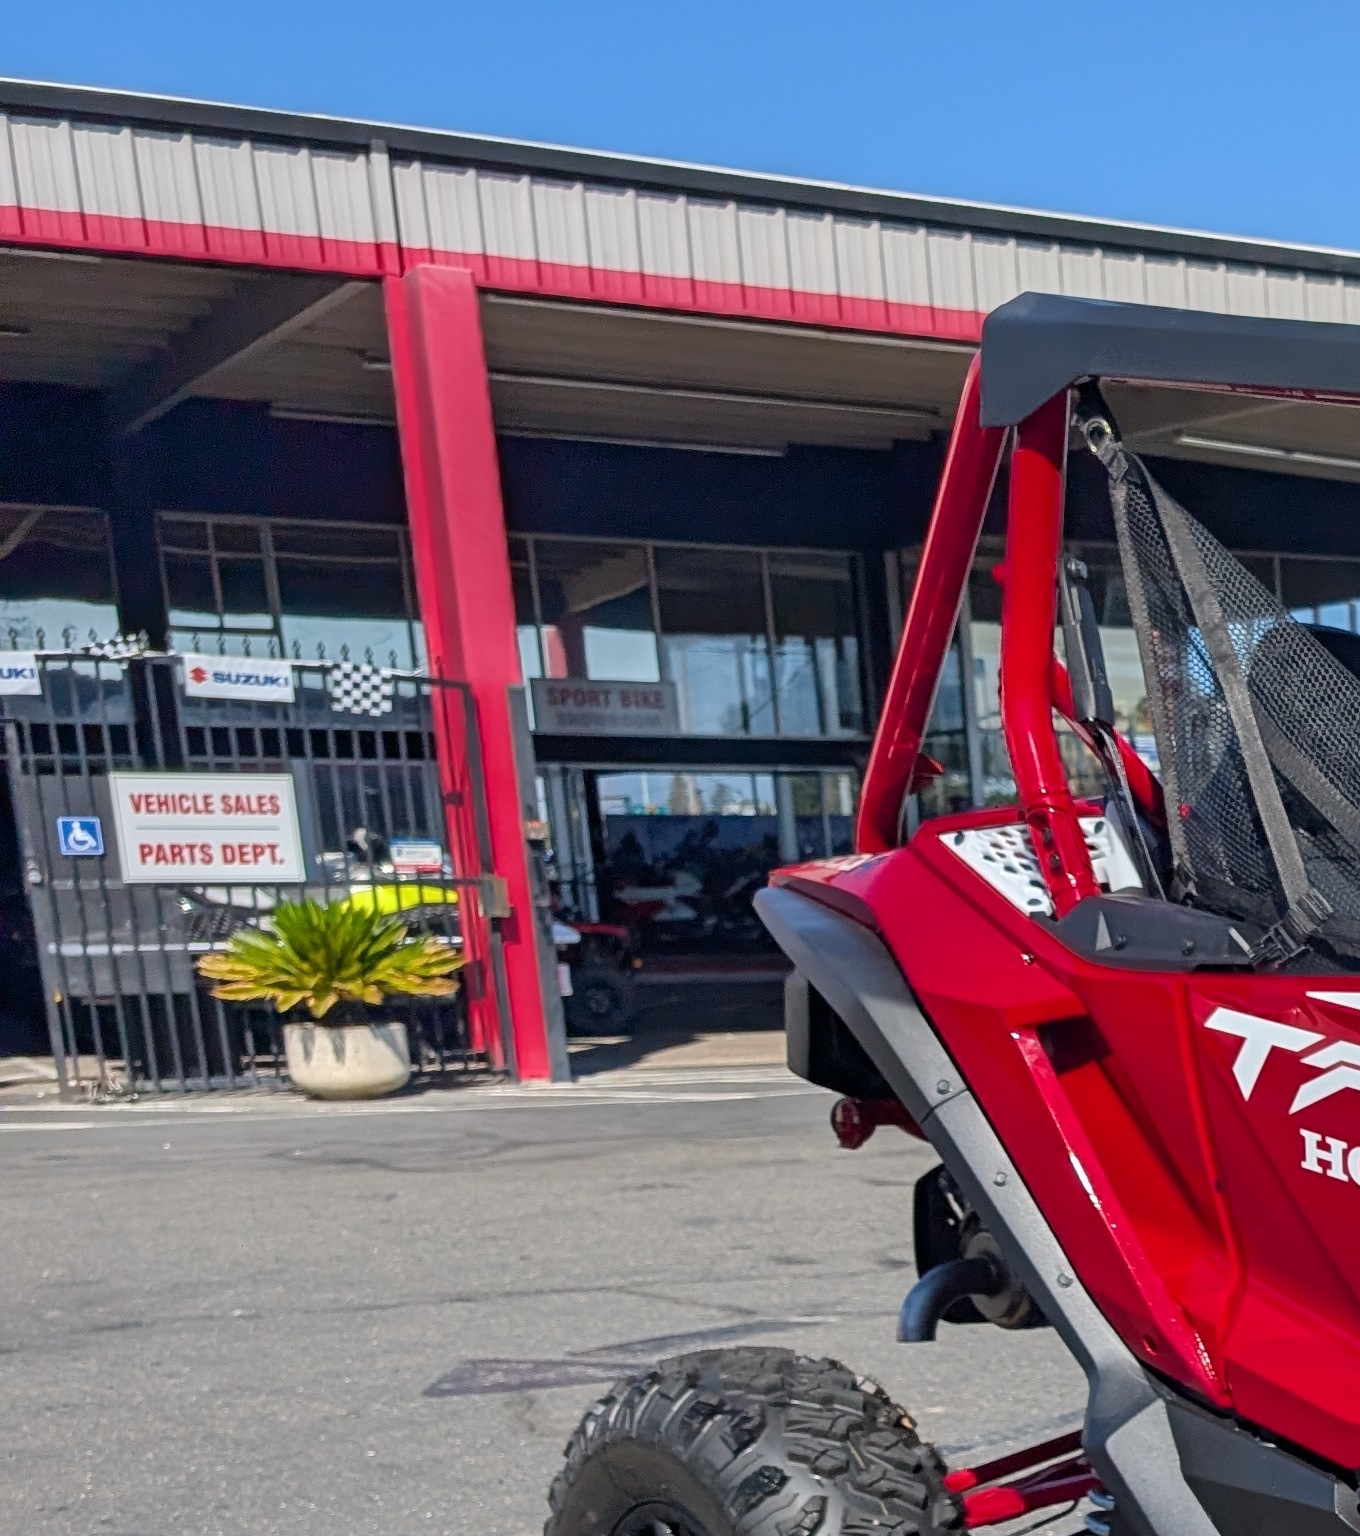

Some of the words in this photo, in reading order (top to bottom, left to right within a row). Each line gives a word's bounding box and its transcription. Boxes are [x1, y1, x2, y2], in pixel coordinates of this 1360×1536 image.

[211, 671, 290, 687] SUZUKI
[546, 686, 612, 707] SPORT
[619, 689, 666, 710] BIKE
[129, 792, 215, 815] VEHICLE
[221, 794, 281, 816] SALES
[139, 843, 214, 865] PARTS
[220, 843, 285, 866] DEPT.
